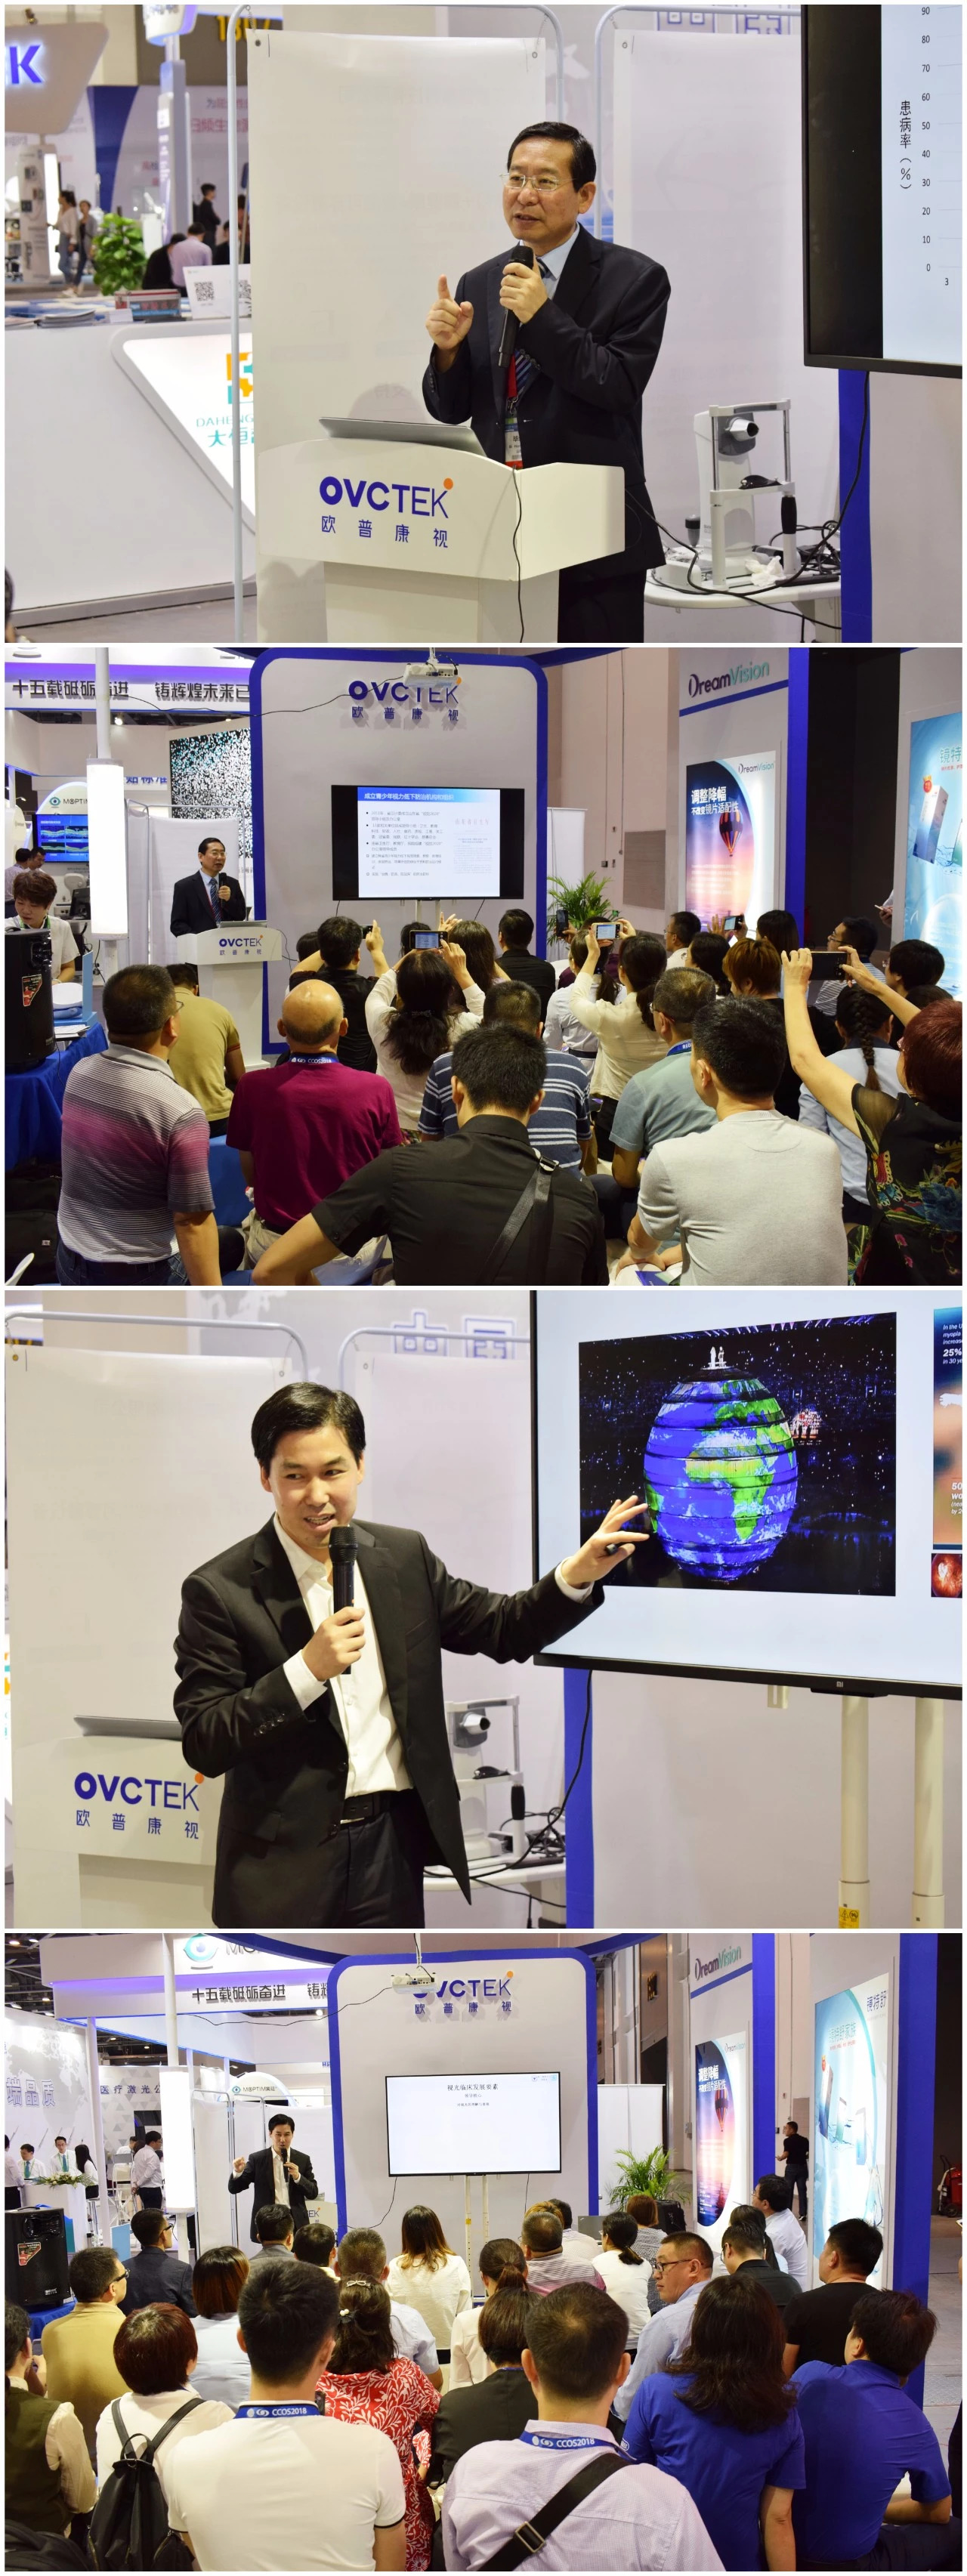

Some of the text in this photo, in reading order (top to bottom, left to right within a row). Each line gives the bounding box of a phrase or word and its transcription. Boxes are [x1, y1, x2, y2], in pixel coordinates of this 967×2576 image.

[922, 7, 930, 15] 90
[922, 122, 930, 130] 50
[922, 207, 930, 215] 20
[208, 427, 254, 448] 大恒
[320, 476, 450, 519] OVCTEK
[321, 514, 448, 548] 欧普康视
[12, 678, 129, 697] 十五载砥砺进
[688, 661, 770, 698] DreamVision
[348, 679, 459, 704] OVCTEK
[351, 706, 459, 721] 欧普康视
[738, 762, 774, 774] DreamVision
[690, 786, 727, 805] 调整降幅
[219, 937, 262, 947] OVCTEK
[943, 1348, 962, 1357] 25%
[74, 1771, 200, 1812] OVCTEK
[76, 1809, 199, 1839] 欧普康视
[695, 1945, 742, 1981] DreamVision
[192, 1984, 286, 2001] 十五载砥砺奋进
[412, 1978, 511, 1999] VCTEK
[415, 2000, 511, 2015] 欧普康视
[272, 2408, 307, 2417] CCOS2018
[556, 2438, 595, 2448] CCOS2018
